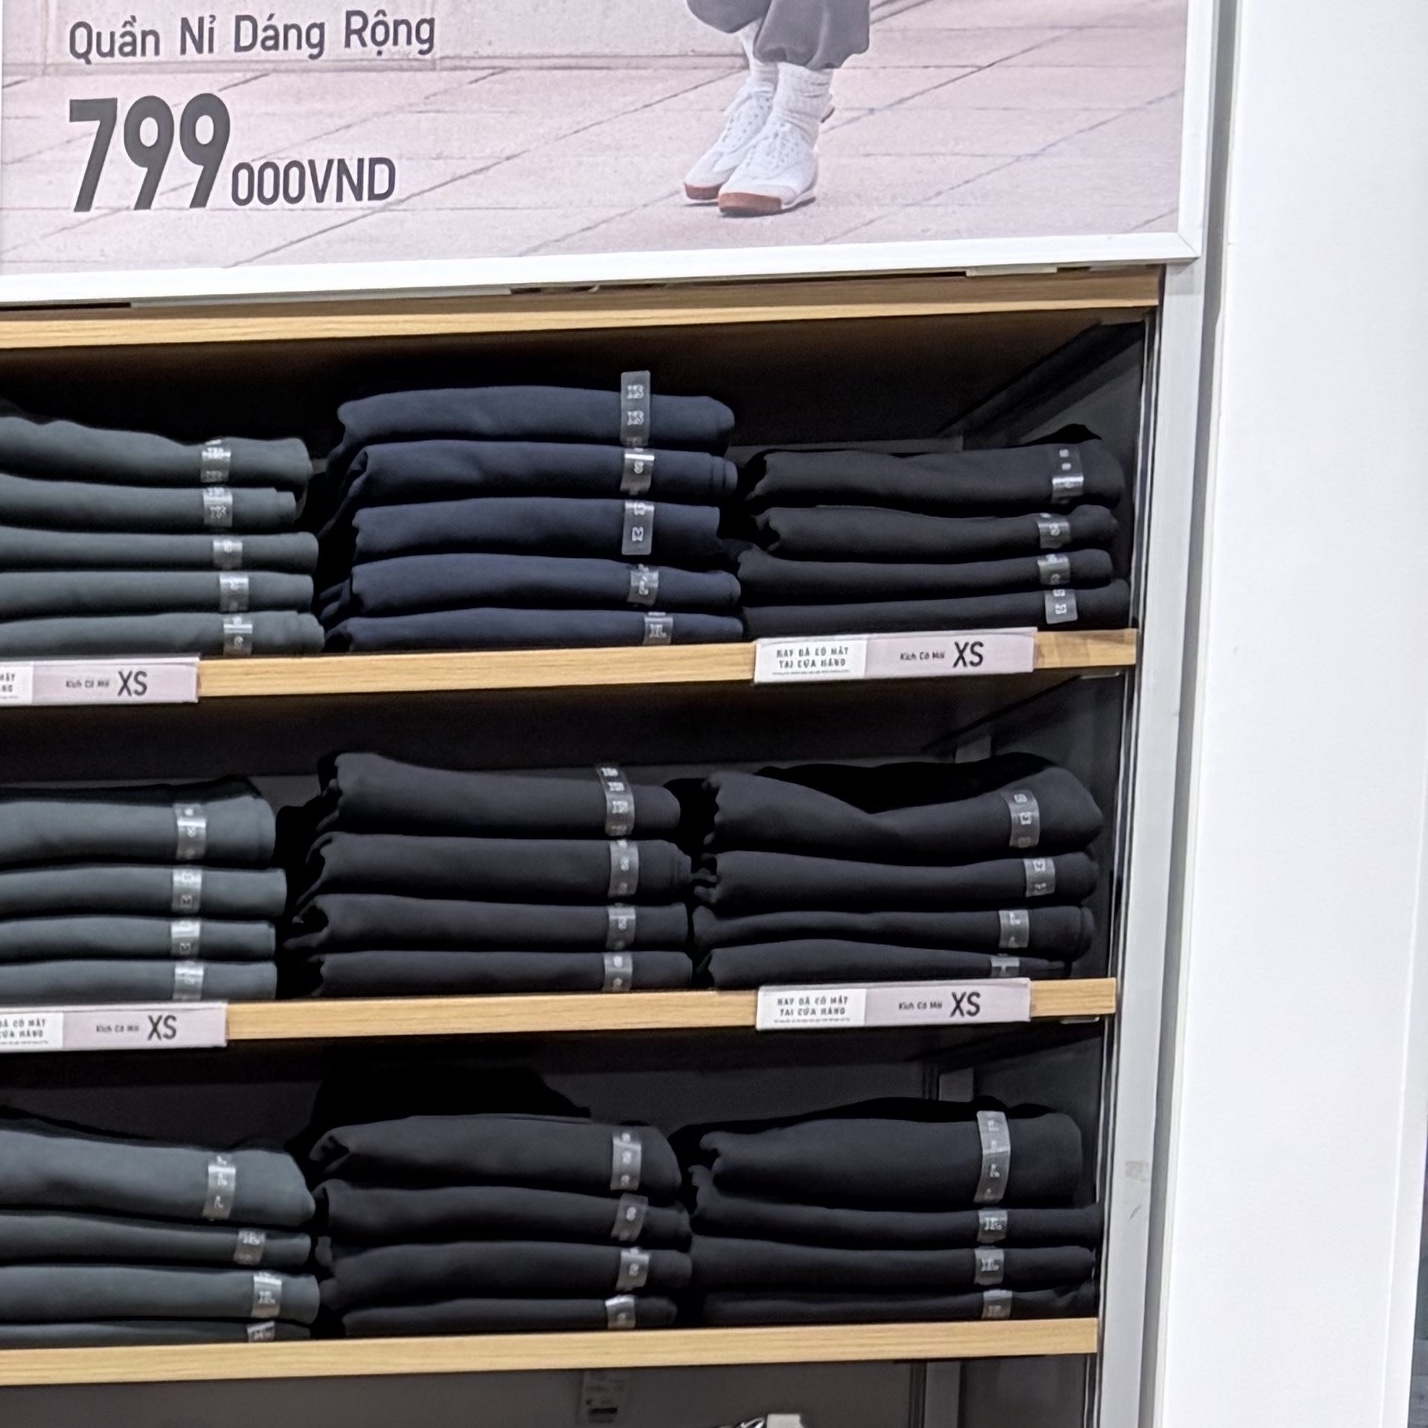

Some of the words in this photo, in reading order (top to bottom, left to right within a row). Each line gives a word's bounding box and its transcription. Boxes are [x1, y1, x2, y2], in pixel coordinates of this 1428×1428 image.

[68, 14, 161, 66] Quần
[179, 13, 217, 56] Nỉ
[233, 12, 326, 62] Dáng
[344, 8, 436, 57] Rộng
[952, 641, 984, 668] XS
[117, 670, 148, 697] XS
[949, 991, 981, 1018] XS
[147, 1014, 178, 1041] XS
